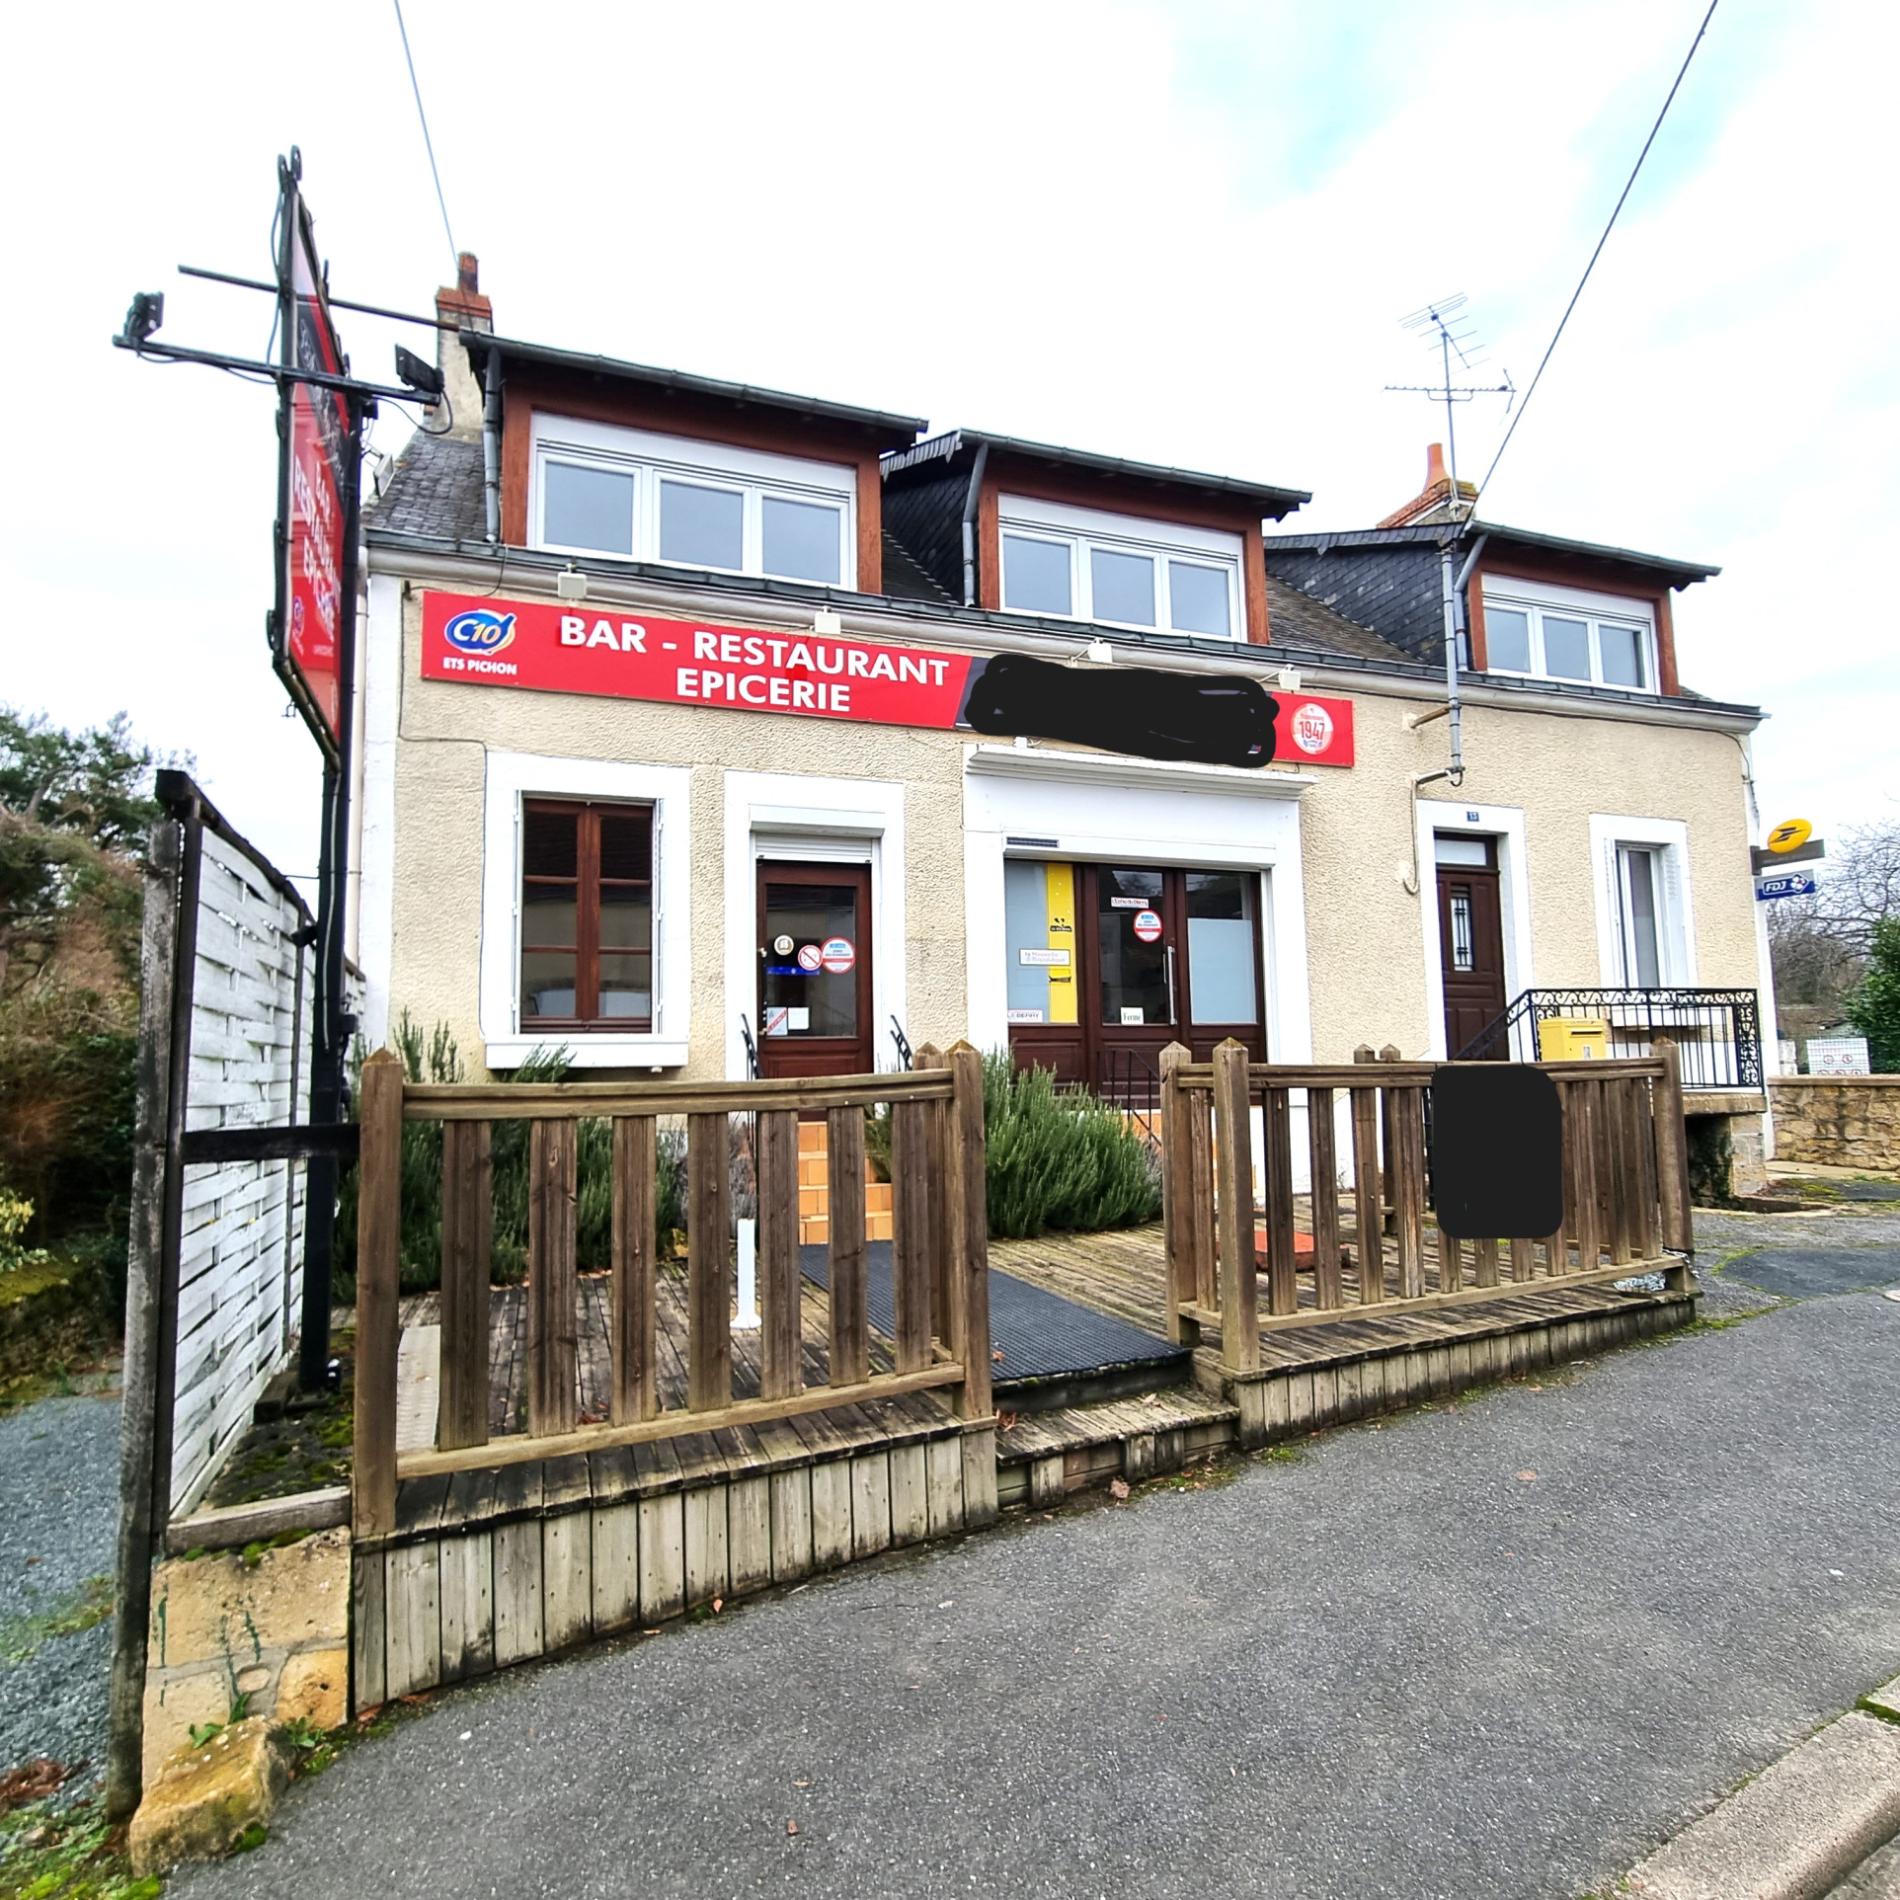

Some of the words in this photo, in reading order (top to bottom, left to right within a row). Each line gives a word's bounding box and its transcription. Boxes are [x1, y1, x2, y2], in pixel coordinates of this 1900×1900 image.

[453, 618, 501, 644] C10
[560, 615, 647, 654] BAR
[693, 630, 949, 686] RESTAURANT
[442, 656, 465, 671] ETS
[467, 659, 518, 676] PICHON
[676, 667, 851, 713] EPICERIE
[1299, 720, 1326, 741] 1947
[1765, 880, 1787, 893] FDJ
